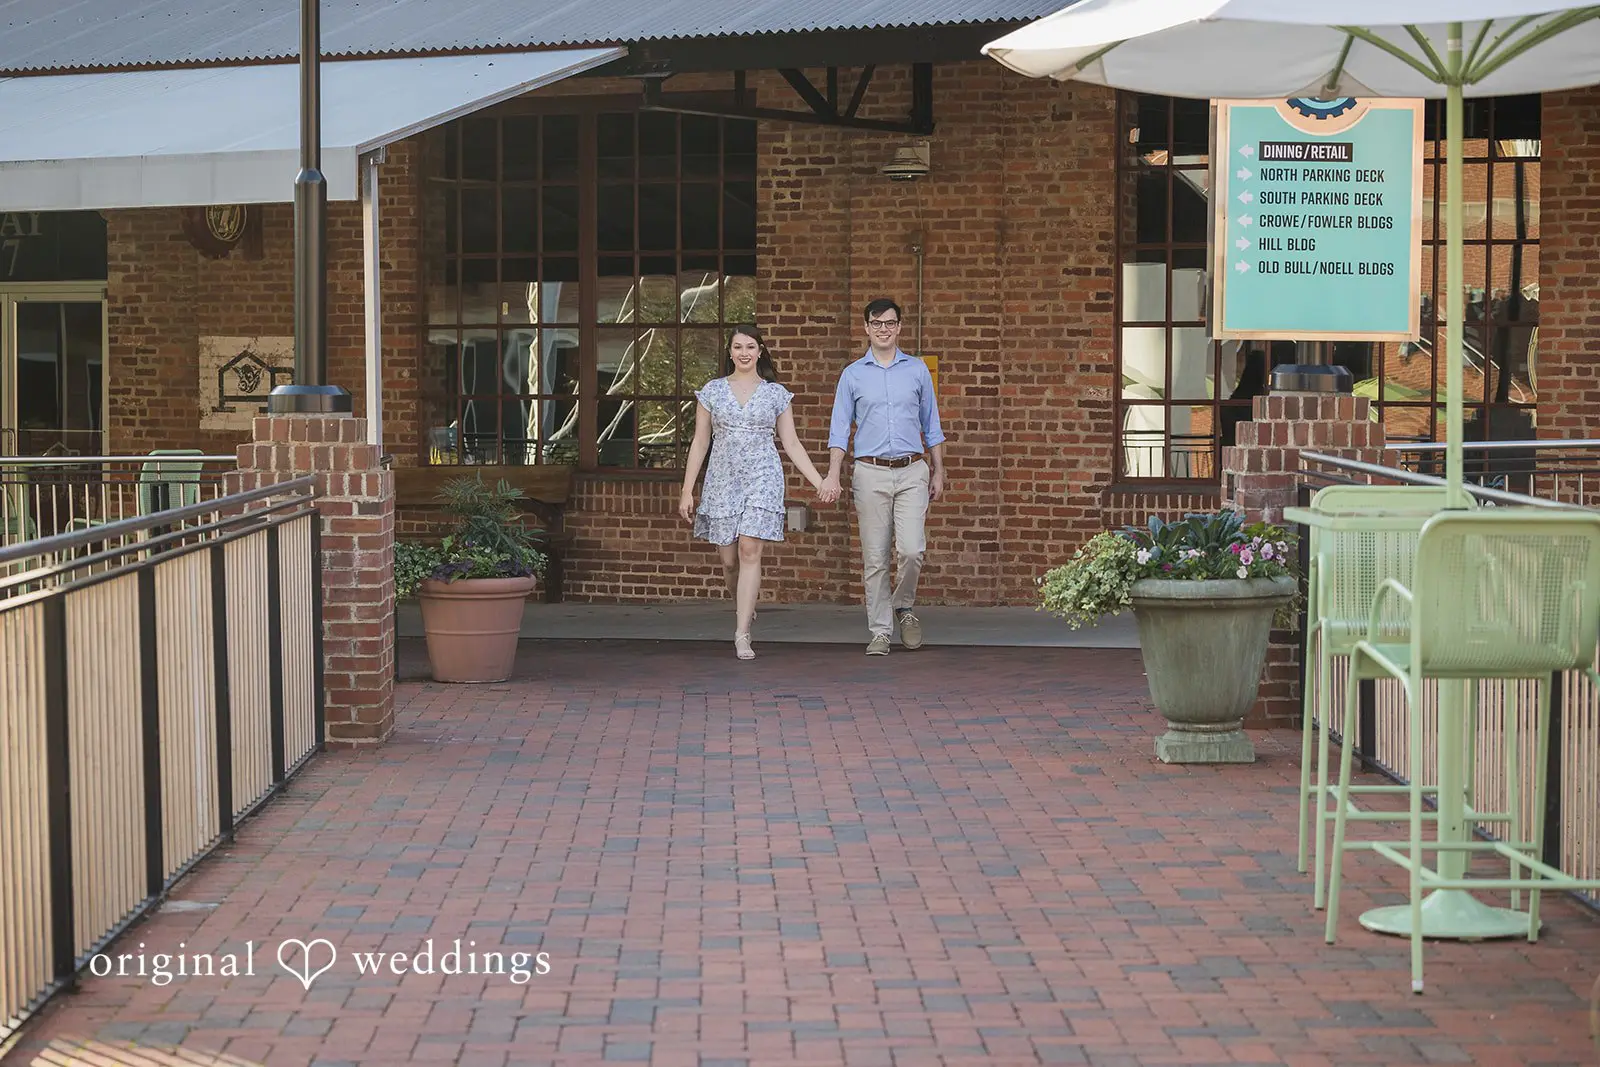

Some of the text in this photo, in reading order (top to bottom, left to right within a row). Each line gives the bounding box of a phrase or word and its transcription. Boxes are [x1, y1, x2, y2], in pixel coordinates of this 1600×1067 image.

[1263, 144, 1349, 159] DINING/RETAIL
[1260, 168, 1385, 183] NORTH PARKING DECK
[1259, 191, 1384, 206] SOUTH PARKING DECK
[1259, 214, 1393, 229] CROWE/FOWLER BLDGS
[1258, 237, 1316, 251] HILL BLDG
[1258, 260, 1394, 276] OLD BULL/NOELL BLDGS
